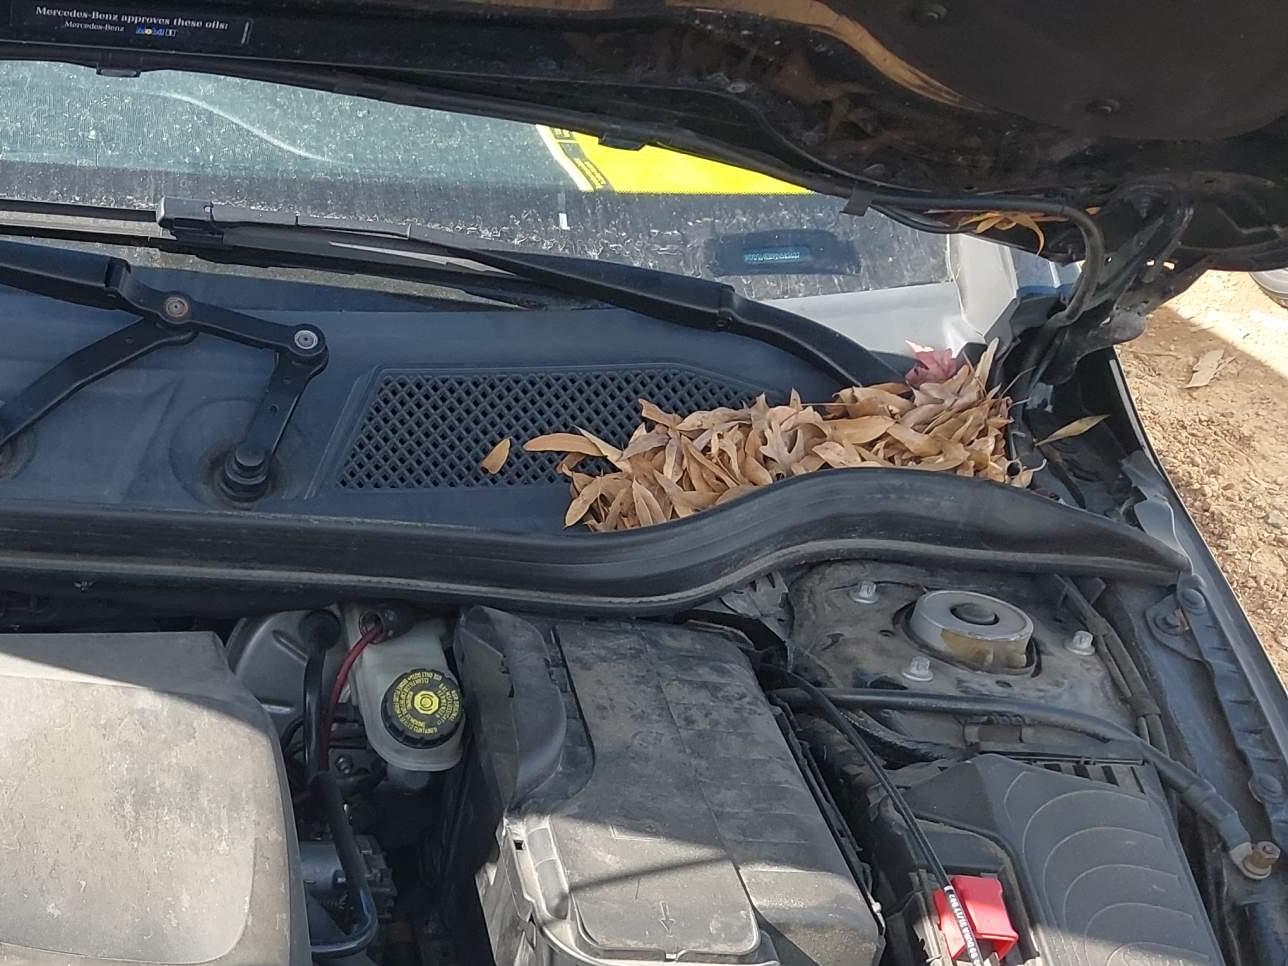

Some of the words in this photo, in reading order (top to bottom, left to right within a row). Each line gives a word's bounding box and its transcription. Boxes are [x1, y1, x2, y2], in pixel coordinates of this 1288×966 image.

[35, 6, 119, 21] Mercedes-Benz
[120, 14, 171, 26] approves
[173, 17, 203, 28] these
[64, 20, 125, 32] Mercedes-Benz
